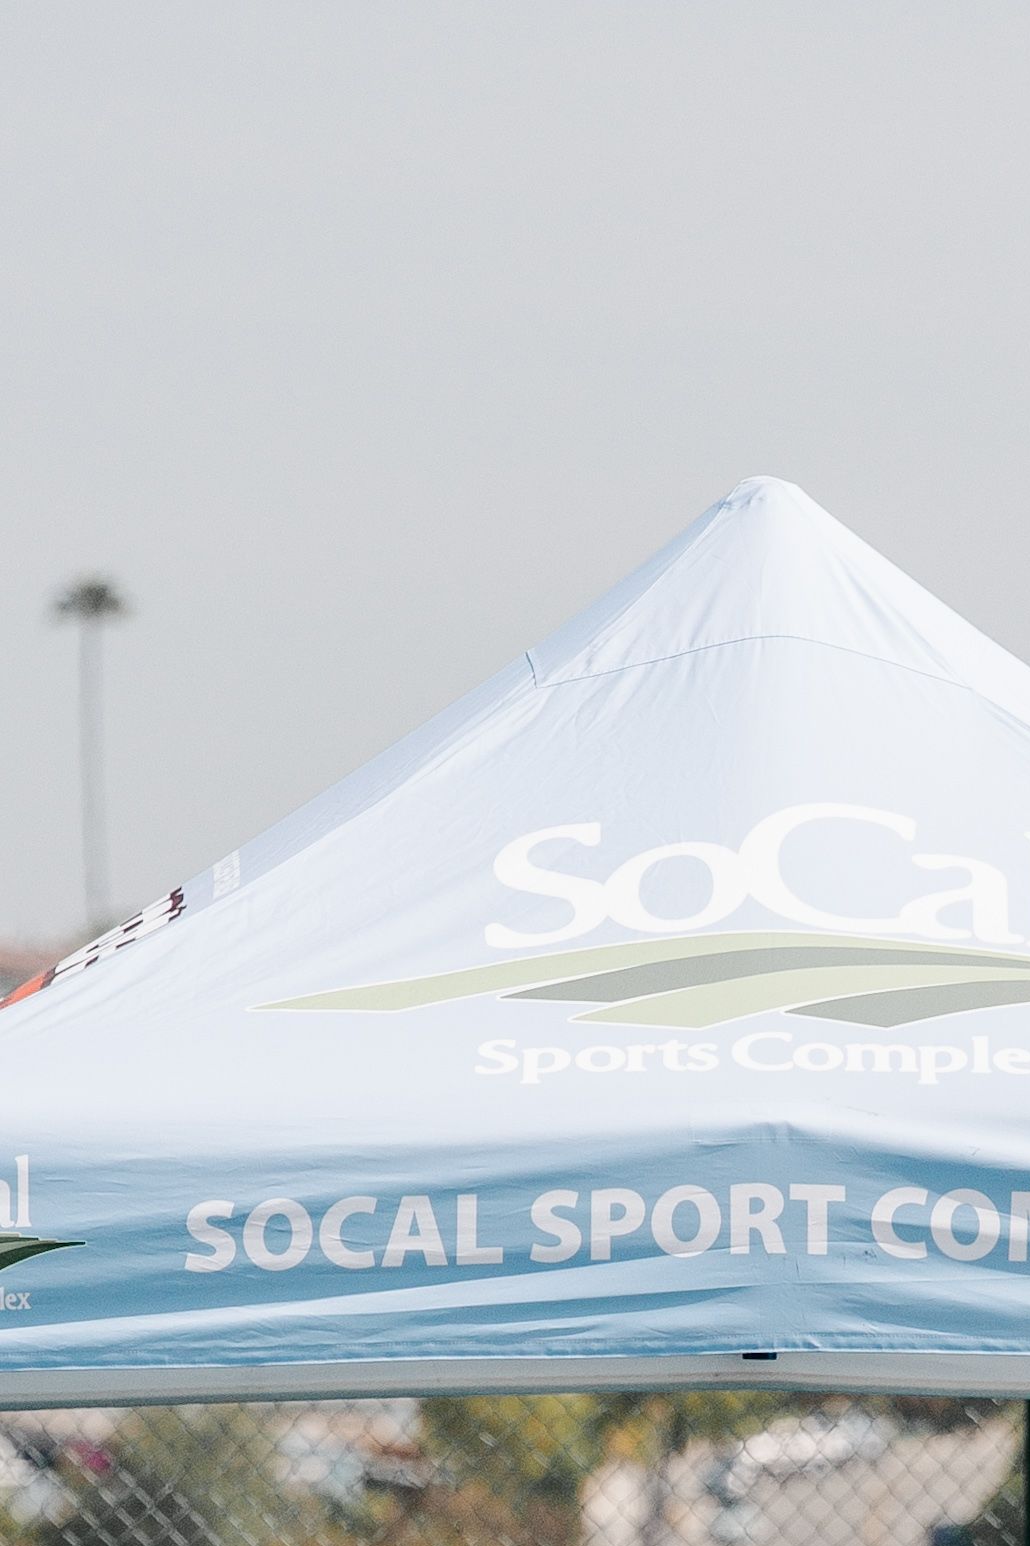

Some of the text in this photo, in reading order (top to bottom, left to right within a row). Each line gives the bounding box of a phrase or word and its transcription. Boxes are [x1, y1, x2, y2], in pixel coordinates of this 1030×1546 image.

[474, 1039, 719, 1085] Sports
[184, 1197, 503, 1274] SOCAL
[530, 1182, 846, 1264] SPORT
